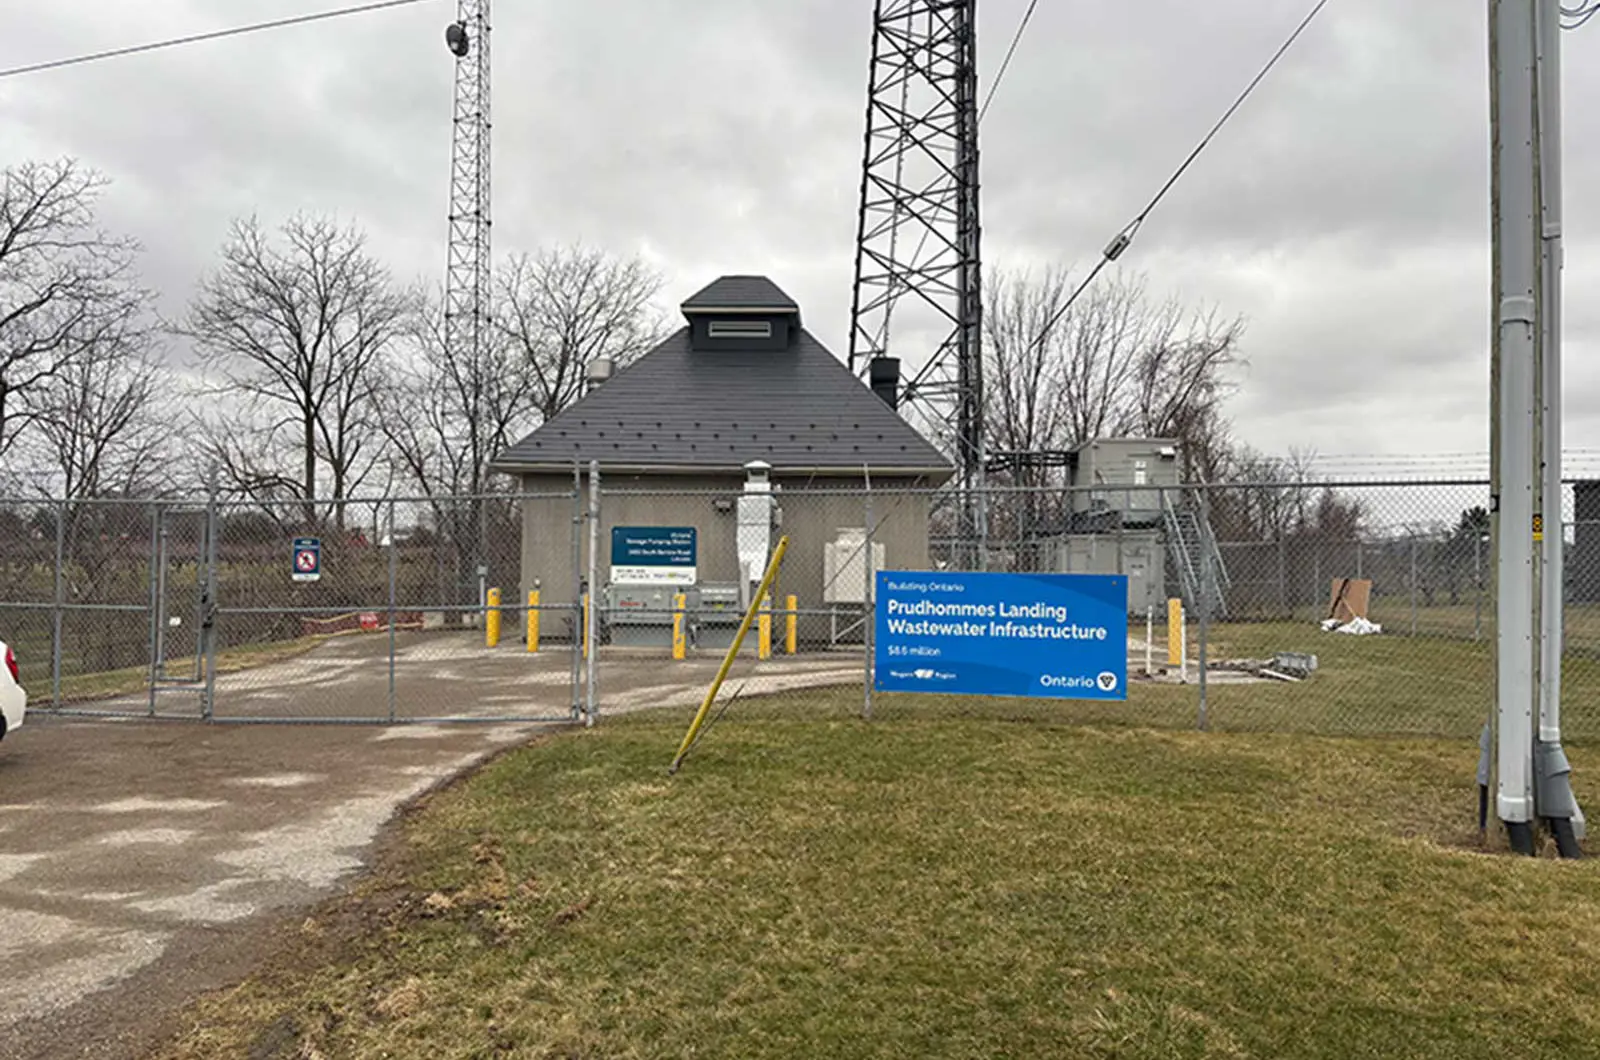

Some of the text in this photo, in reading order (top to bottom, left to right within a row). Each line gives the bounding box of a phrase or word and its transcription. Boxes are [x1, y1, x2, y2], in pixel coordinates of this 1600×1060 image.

[888, 581, 964, 593] Building Ontario
[888, 599, 1067, 623] Prudhommes Landing
[887, 619, 1107, 641] Wastewater Infrastructure
[909, 646, 941, 656] million
[1040, 674, 1095, 688] Ontario
